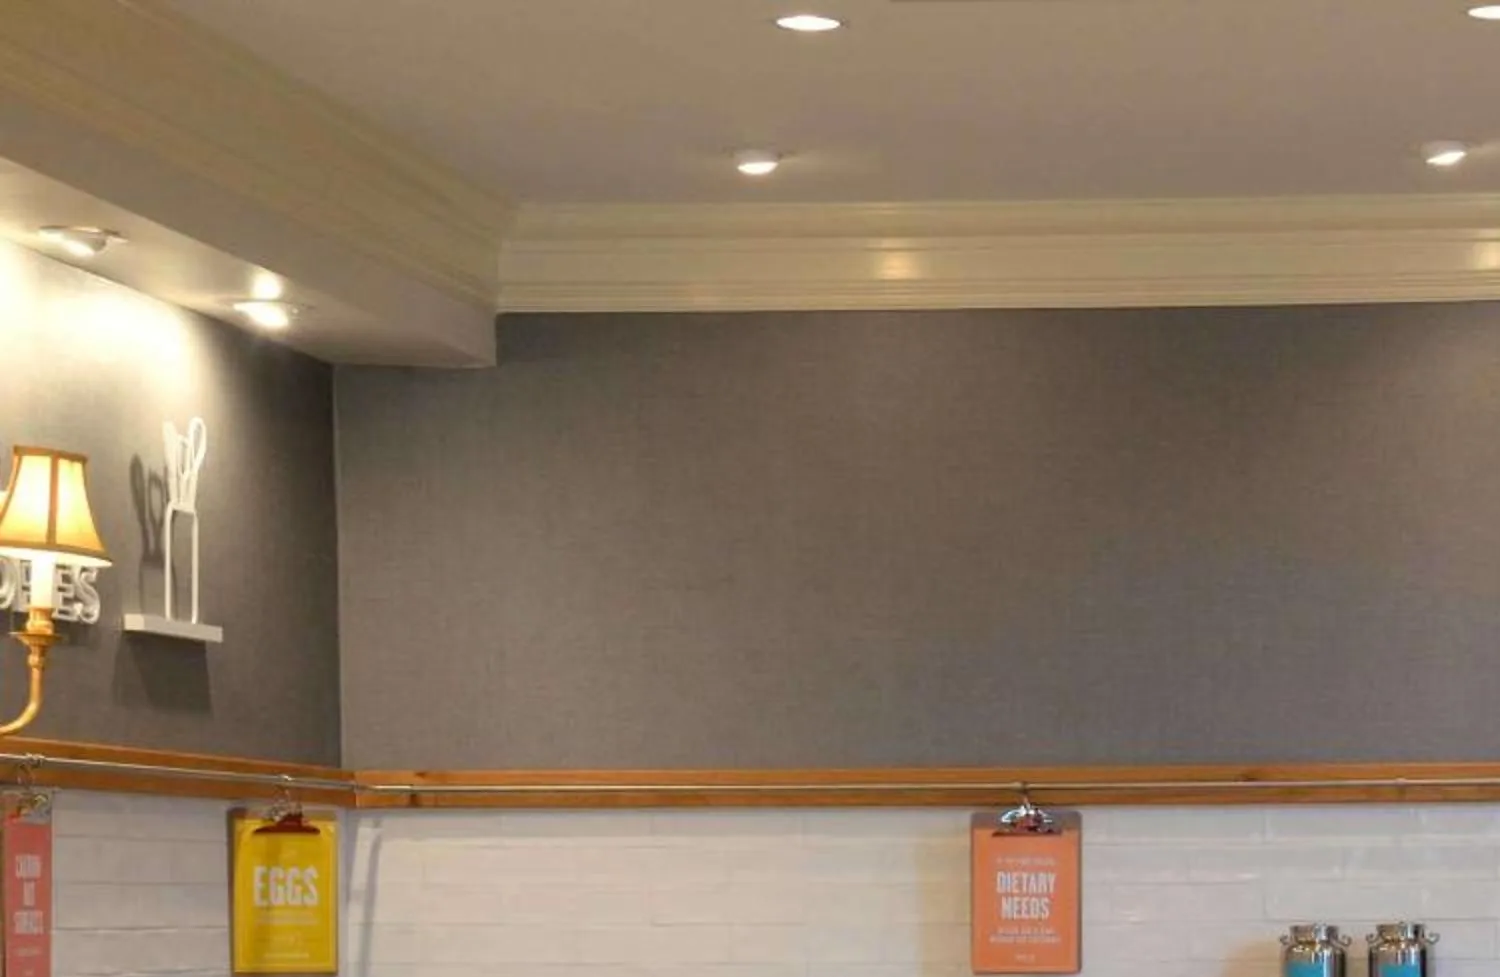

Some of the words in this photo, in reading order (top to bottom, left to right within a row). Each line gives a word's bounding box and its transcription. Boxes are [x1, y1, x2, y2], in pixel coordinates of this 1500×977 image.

[253, 865, 320, 907] EGGS
[996, 871, 1057, 895] DIETARY
[1001, 896, 1051, 920] NEEDS
